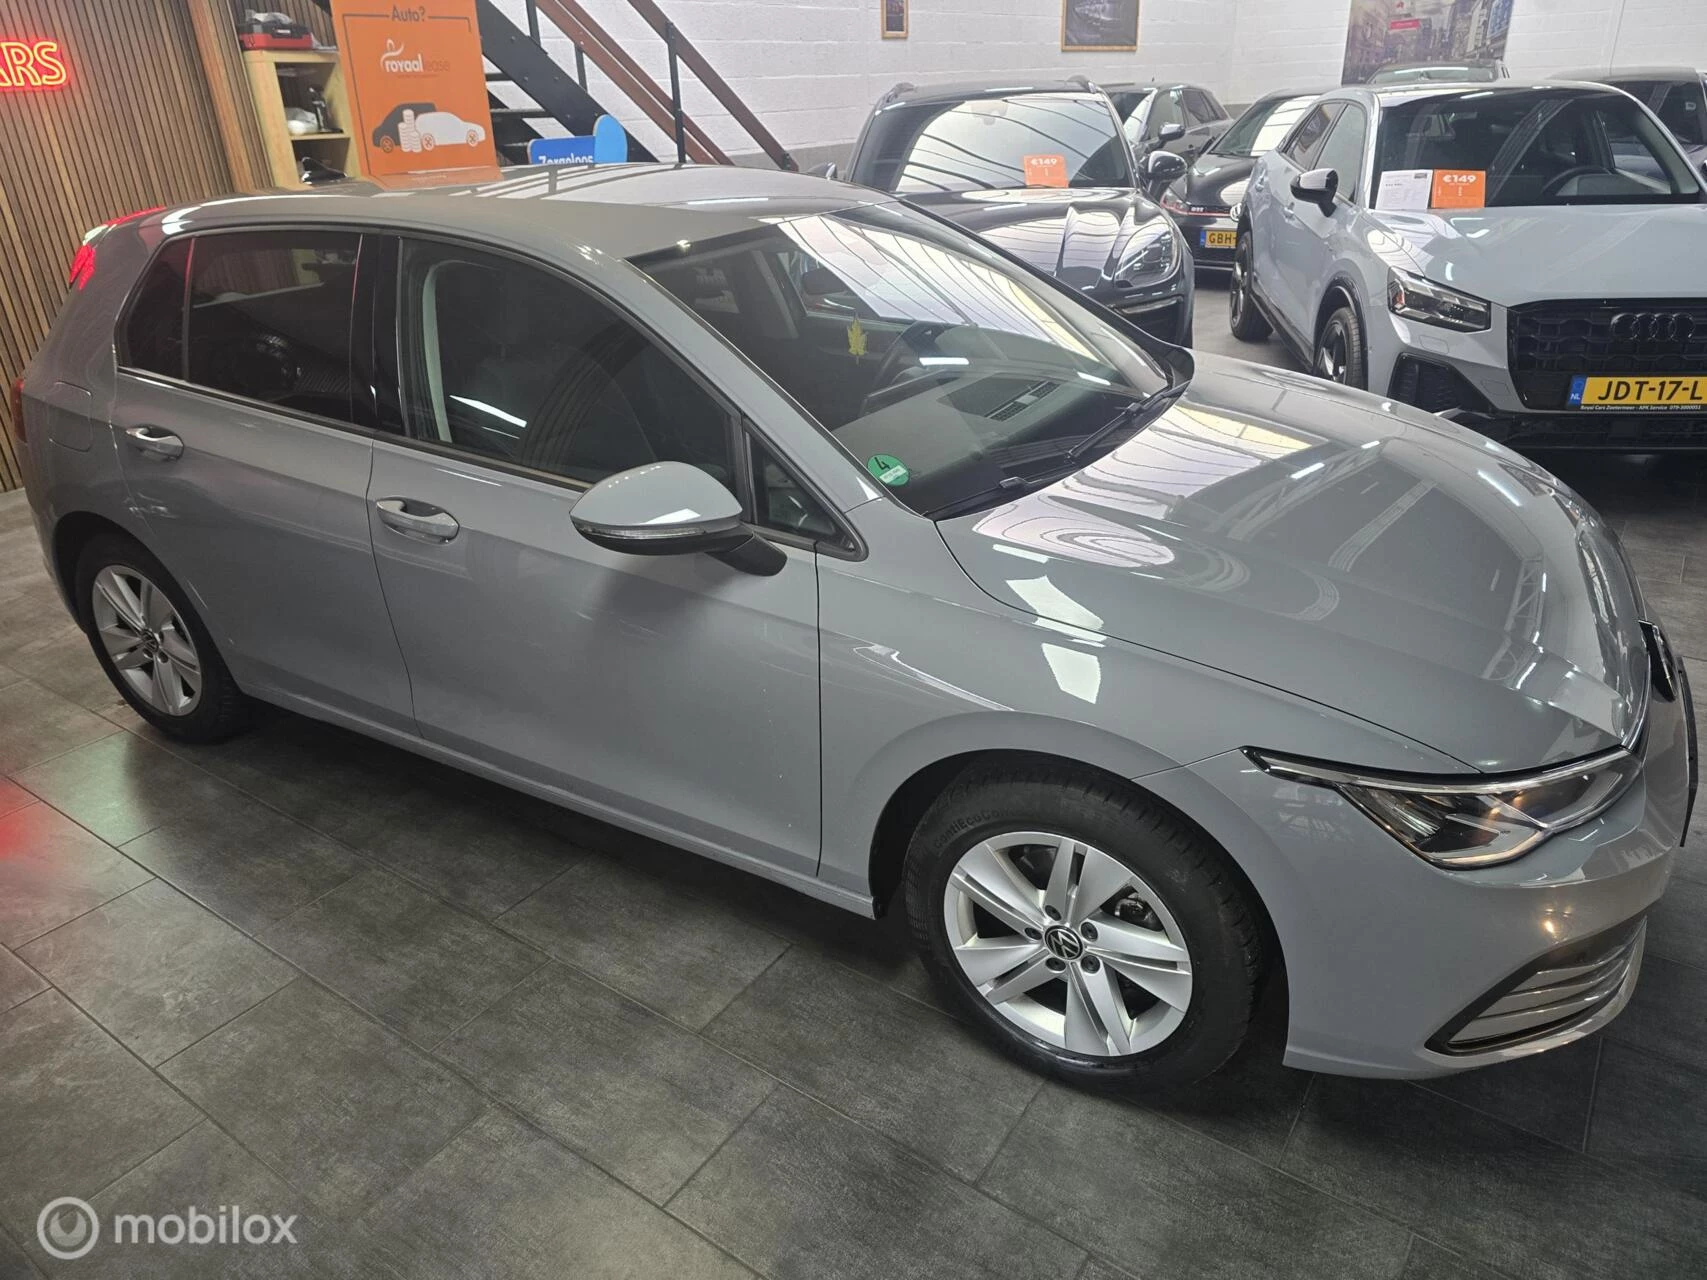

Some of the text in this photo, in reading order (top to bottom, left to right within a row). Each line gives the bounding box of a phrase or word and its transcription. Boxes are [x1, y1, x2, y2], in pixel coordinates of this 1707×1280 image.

[391, 4, 425, 22] Auto?
[1442, 174, 1477, 183] €149
[1598, 380, 1703, 401] JDT-17-L
[874, 456, 891, 470] 4
